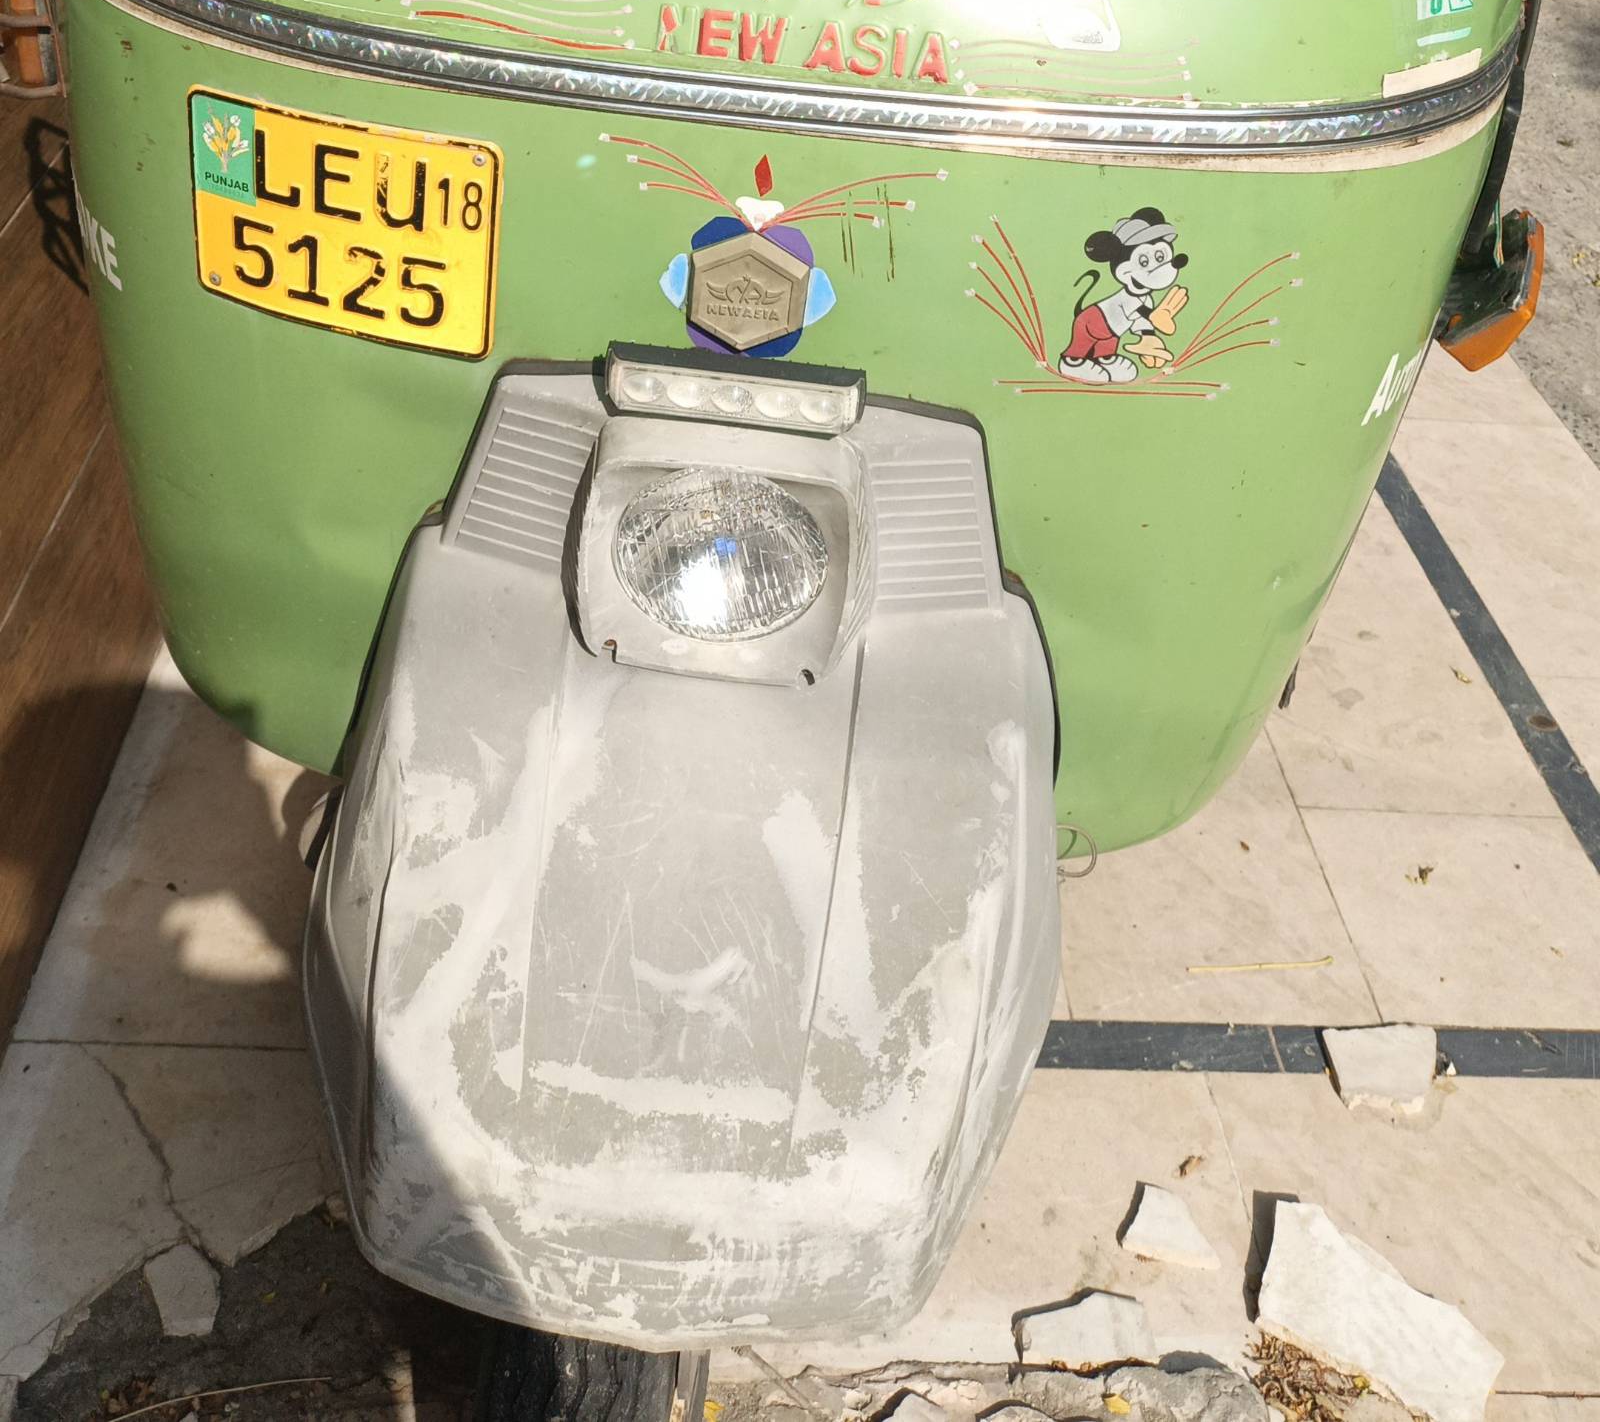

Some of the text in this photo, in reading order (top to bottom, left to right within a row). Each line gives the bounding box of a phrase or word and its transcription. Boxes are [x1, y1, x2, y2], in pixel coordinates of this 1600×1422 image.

[658, 3, 949, 84] NEW ASIA
[204, 171, 250, 193] PUNJAB
[254, 128, 485, 232] LEU 18
[233, 215, 446, 328] 5125
